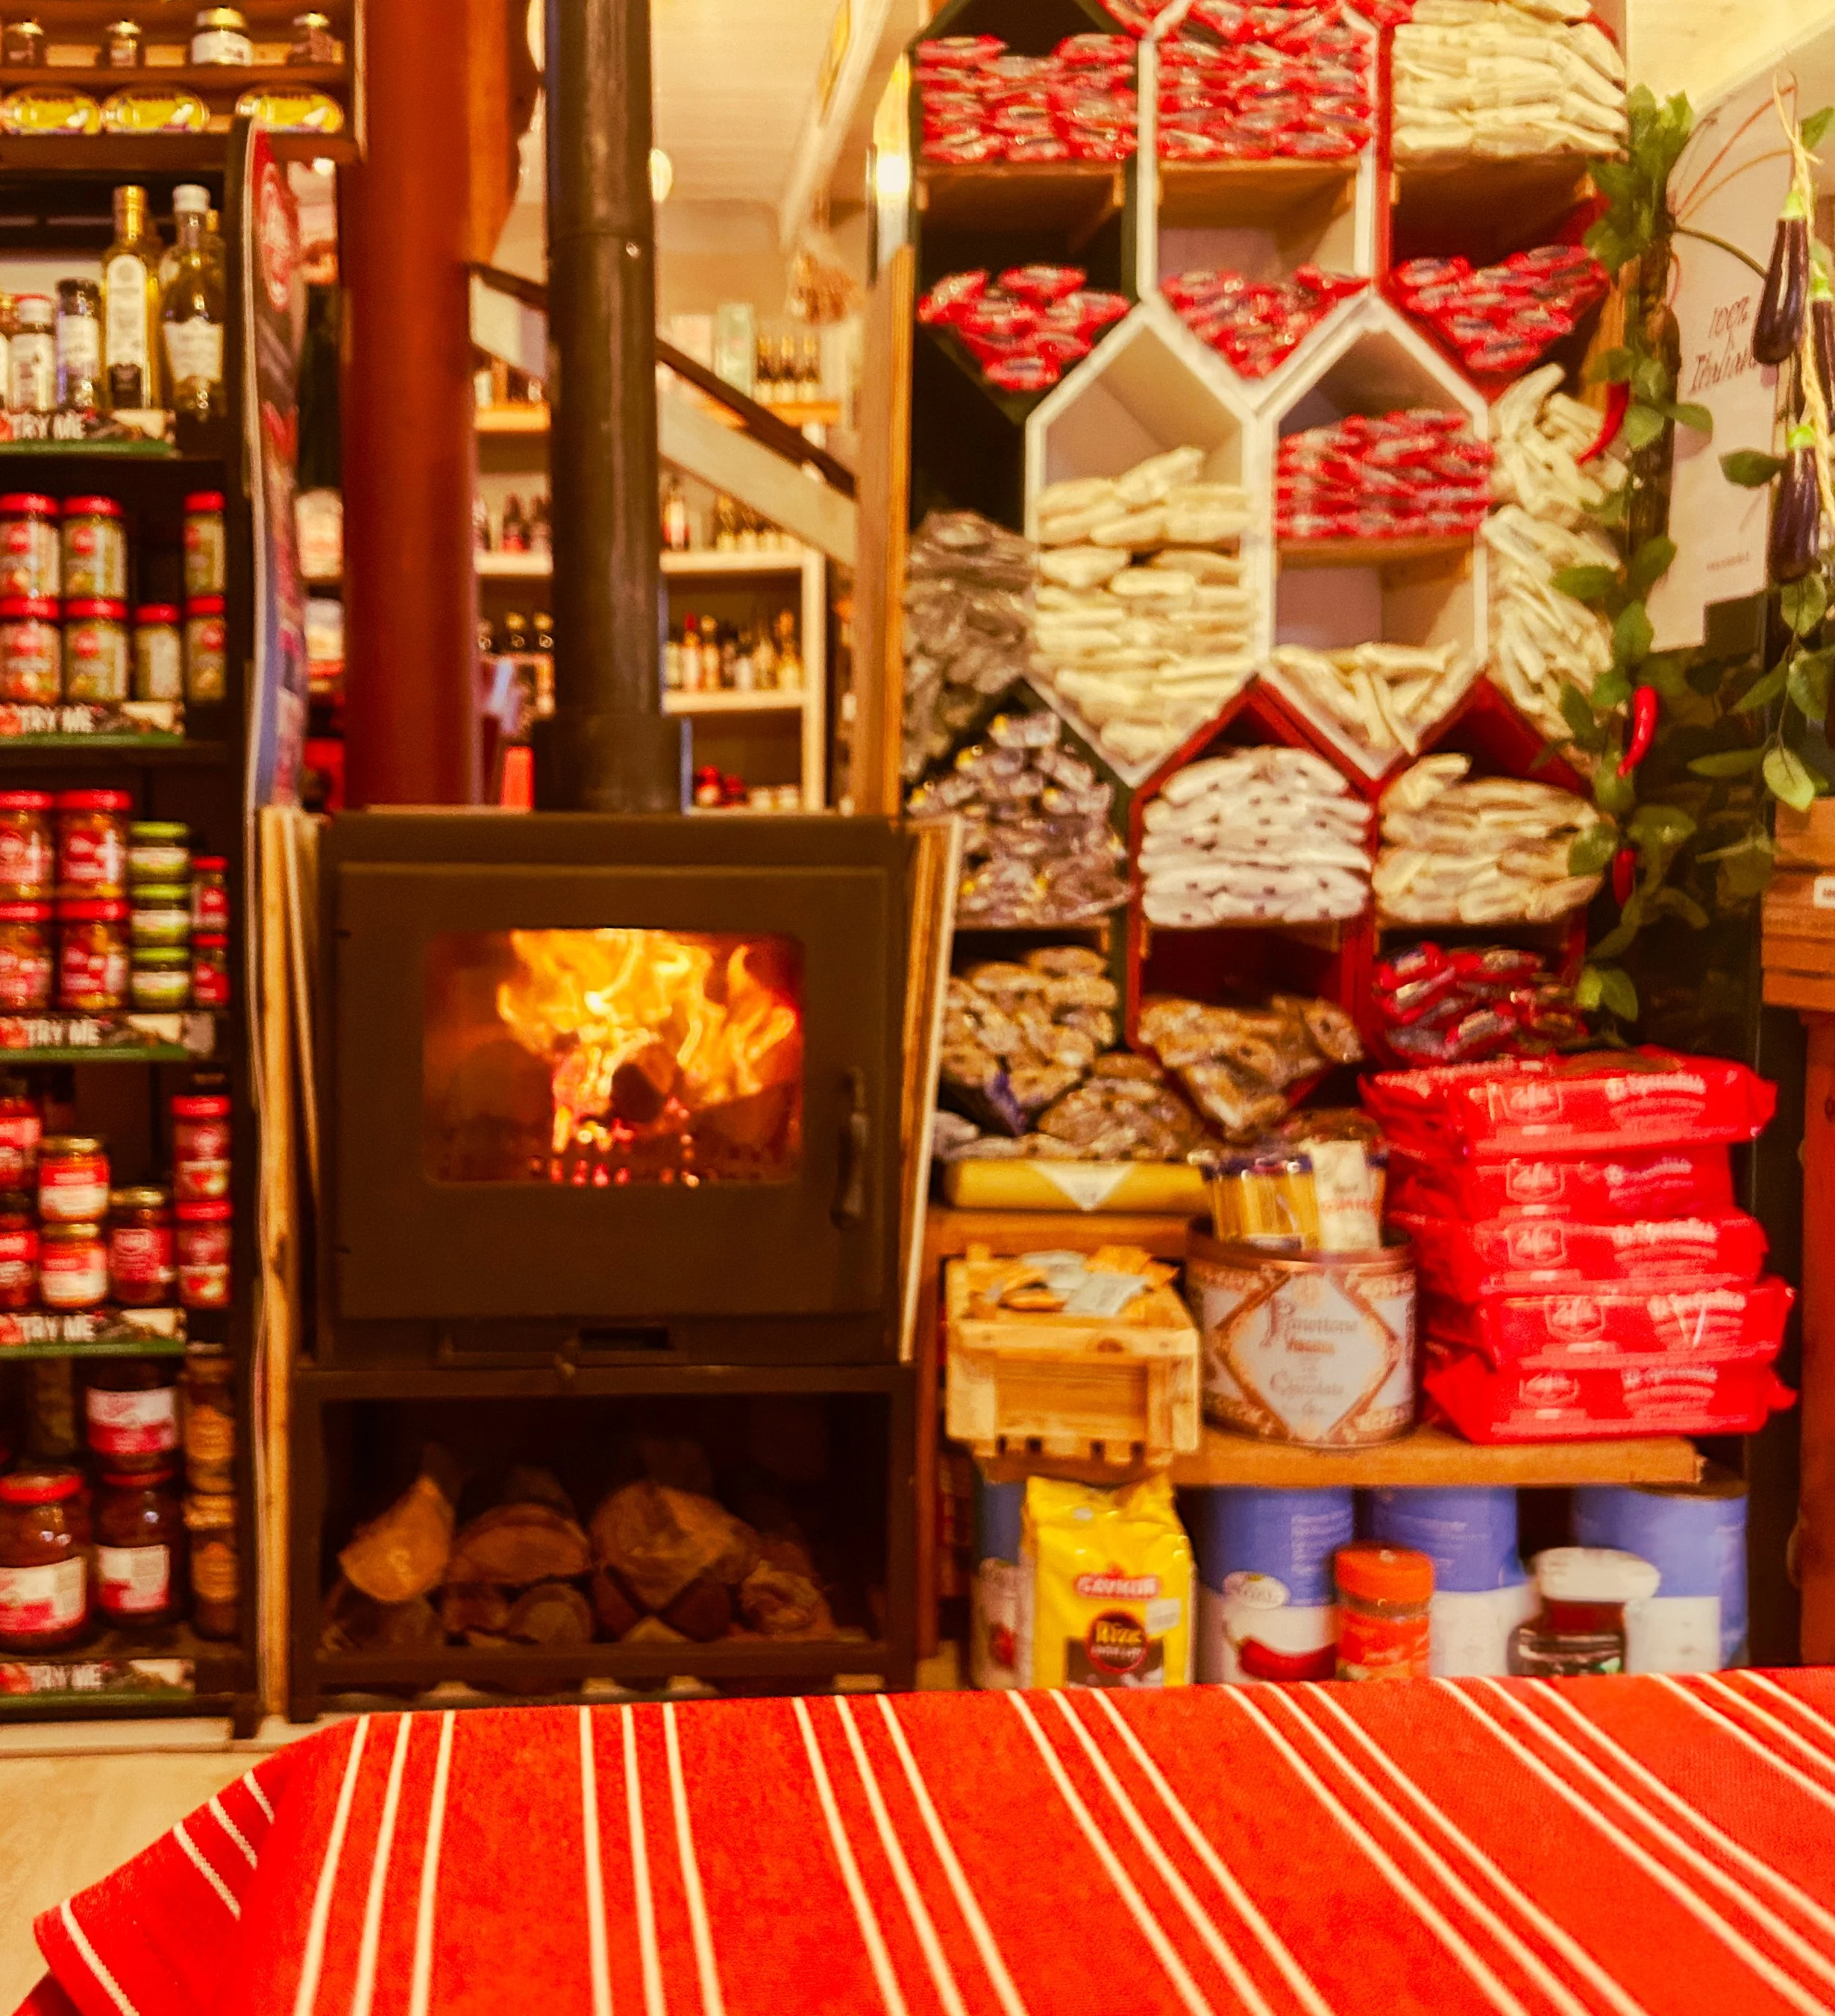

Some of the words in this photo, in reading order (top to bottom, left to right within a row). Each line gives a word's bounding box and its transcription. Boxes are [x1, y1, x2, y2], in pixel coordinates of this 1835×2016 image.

[9, 412, 51, 440] TRY
[53, 411, 86, 440] ME
[17, 705, 59, 733] TRY
[62, 705, 93, 733] ME
[22, 1019, 63, 1047] TRY
[68, 1018, 101, 1047] ME
[16, 1316, 59, 1342] TRY
[63, 1315, 95, 1342] ME
